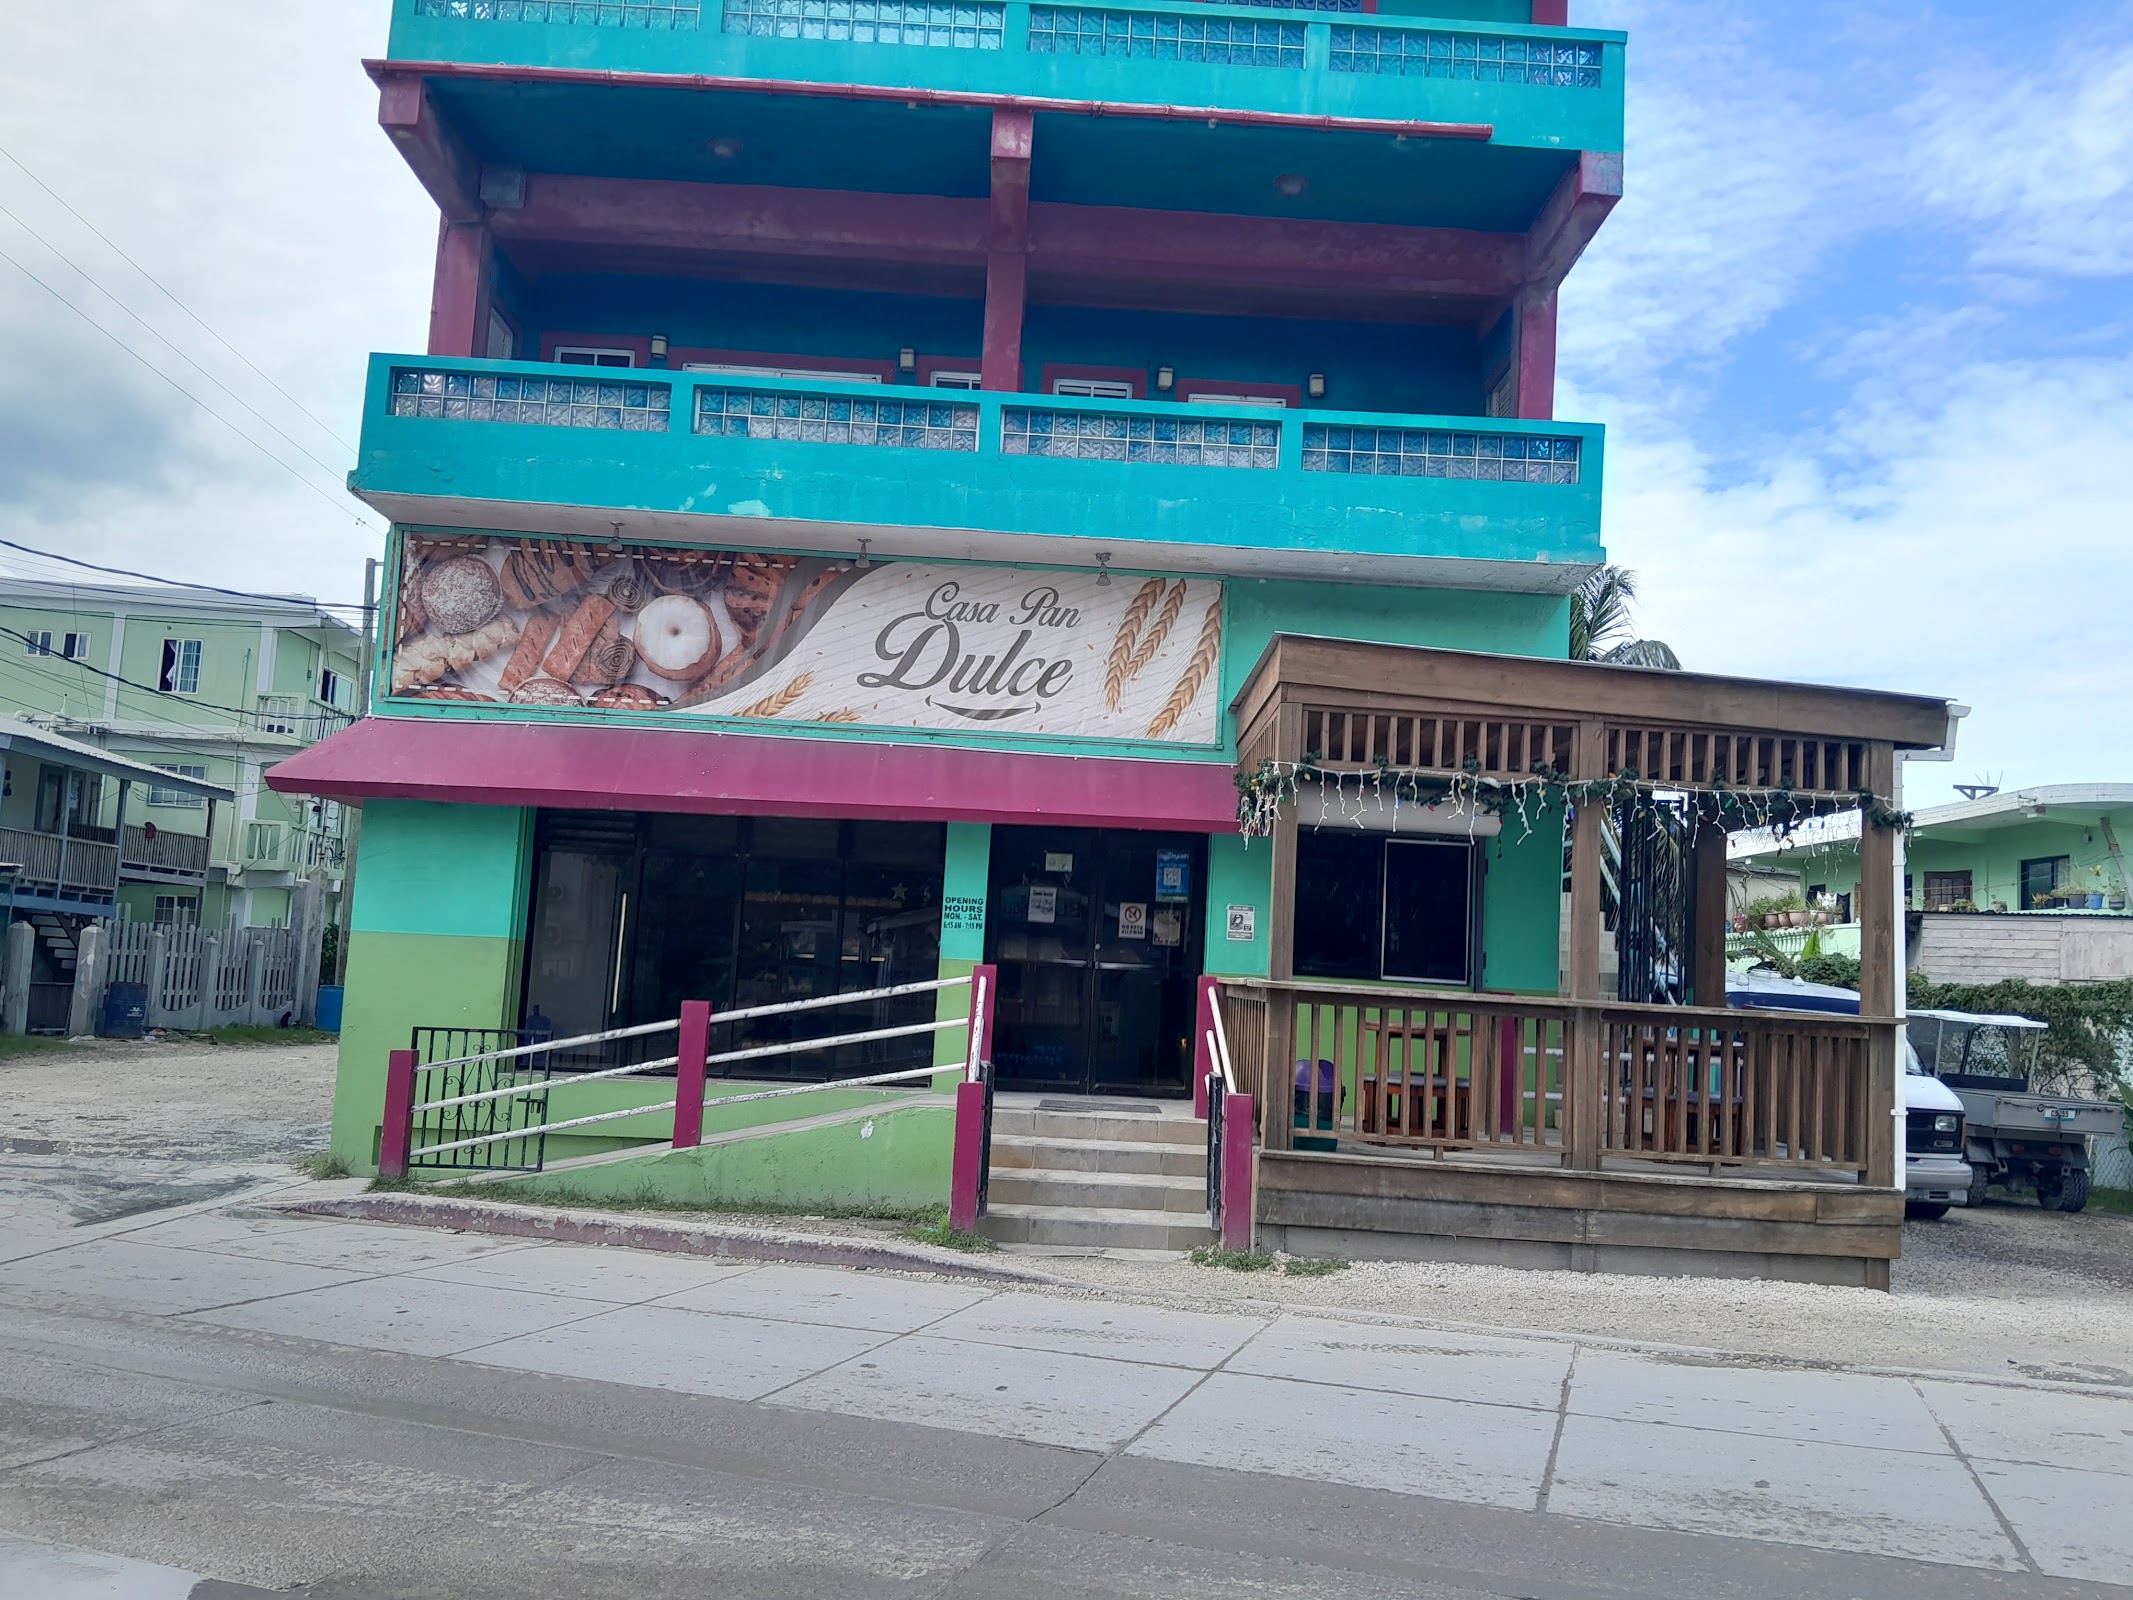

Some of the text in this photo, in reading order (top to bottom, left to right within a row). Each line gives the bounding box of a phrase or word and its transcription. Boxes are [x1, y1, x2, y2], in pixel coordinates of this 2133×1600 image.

[925, 581, 1081, 628] Casa Pan
[856, 611, 1074, 698] Dulce
[945, 896, 984, 905] OPENING
[944, 904, 983, 913] HOURS
[943, 912, 962, 920] MON.
[968, 913, 983, 921] SAT.
